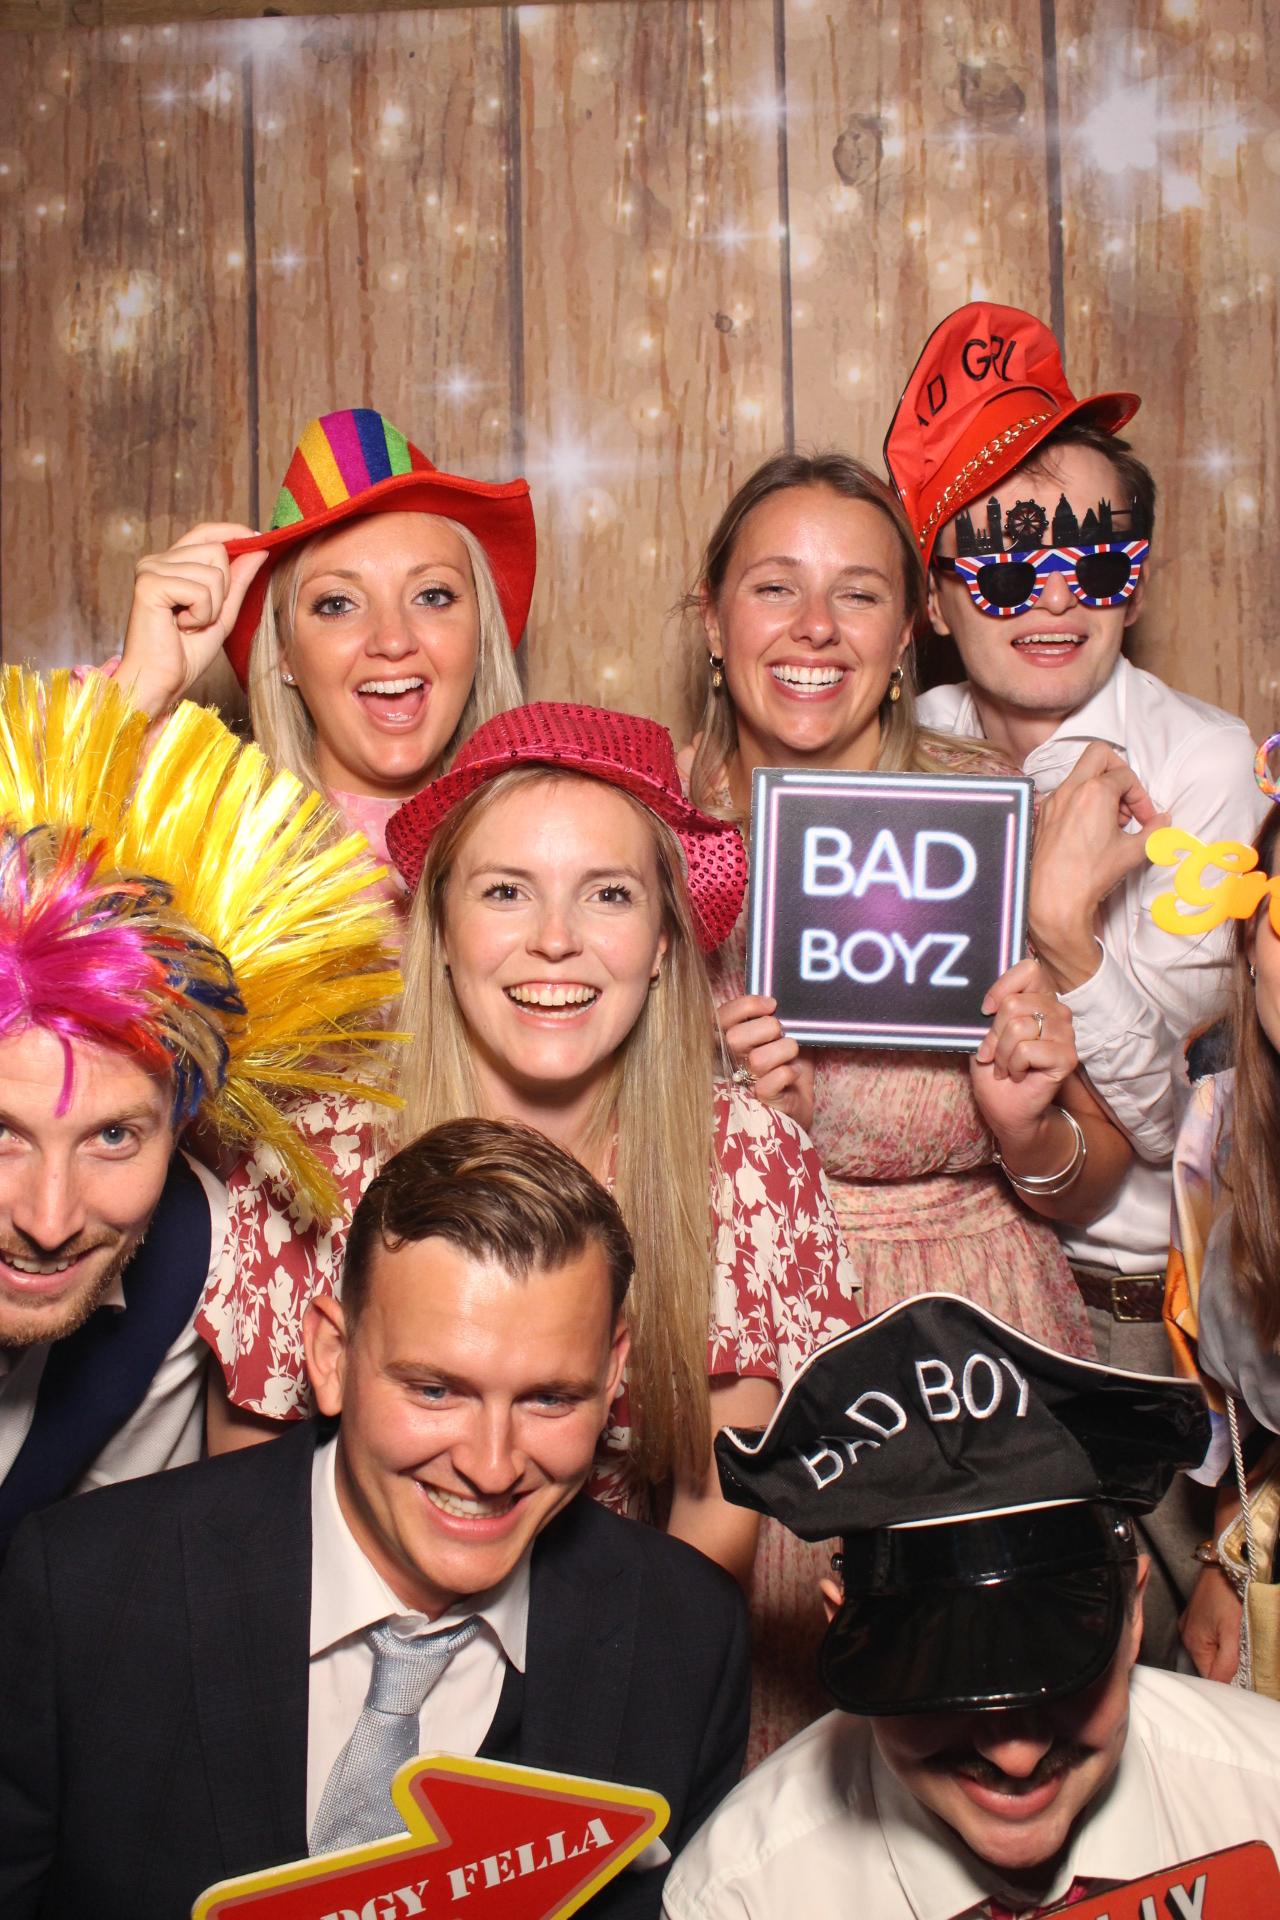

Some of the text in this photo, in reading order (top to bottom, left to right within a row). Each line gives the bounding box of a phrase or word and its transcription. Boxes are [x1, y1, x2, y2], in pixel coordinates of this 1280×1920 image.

[803, 826, 977, 901] BAD
[800, 929, 970, 987] BOYZ
[800, 1353, 1029, 1490] BAD BOY
[446, 1817, 614, 1901] FELLA
